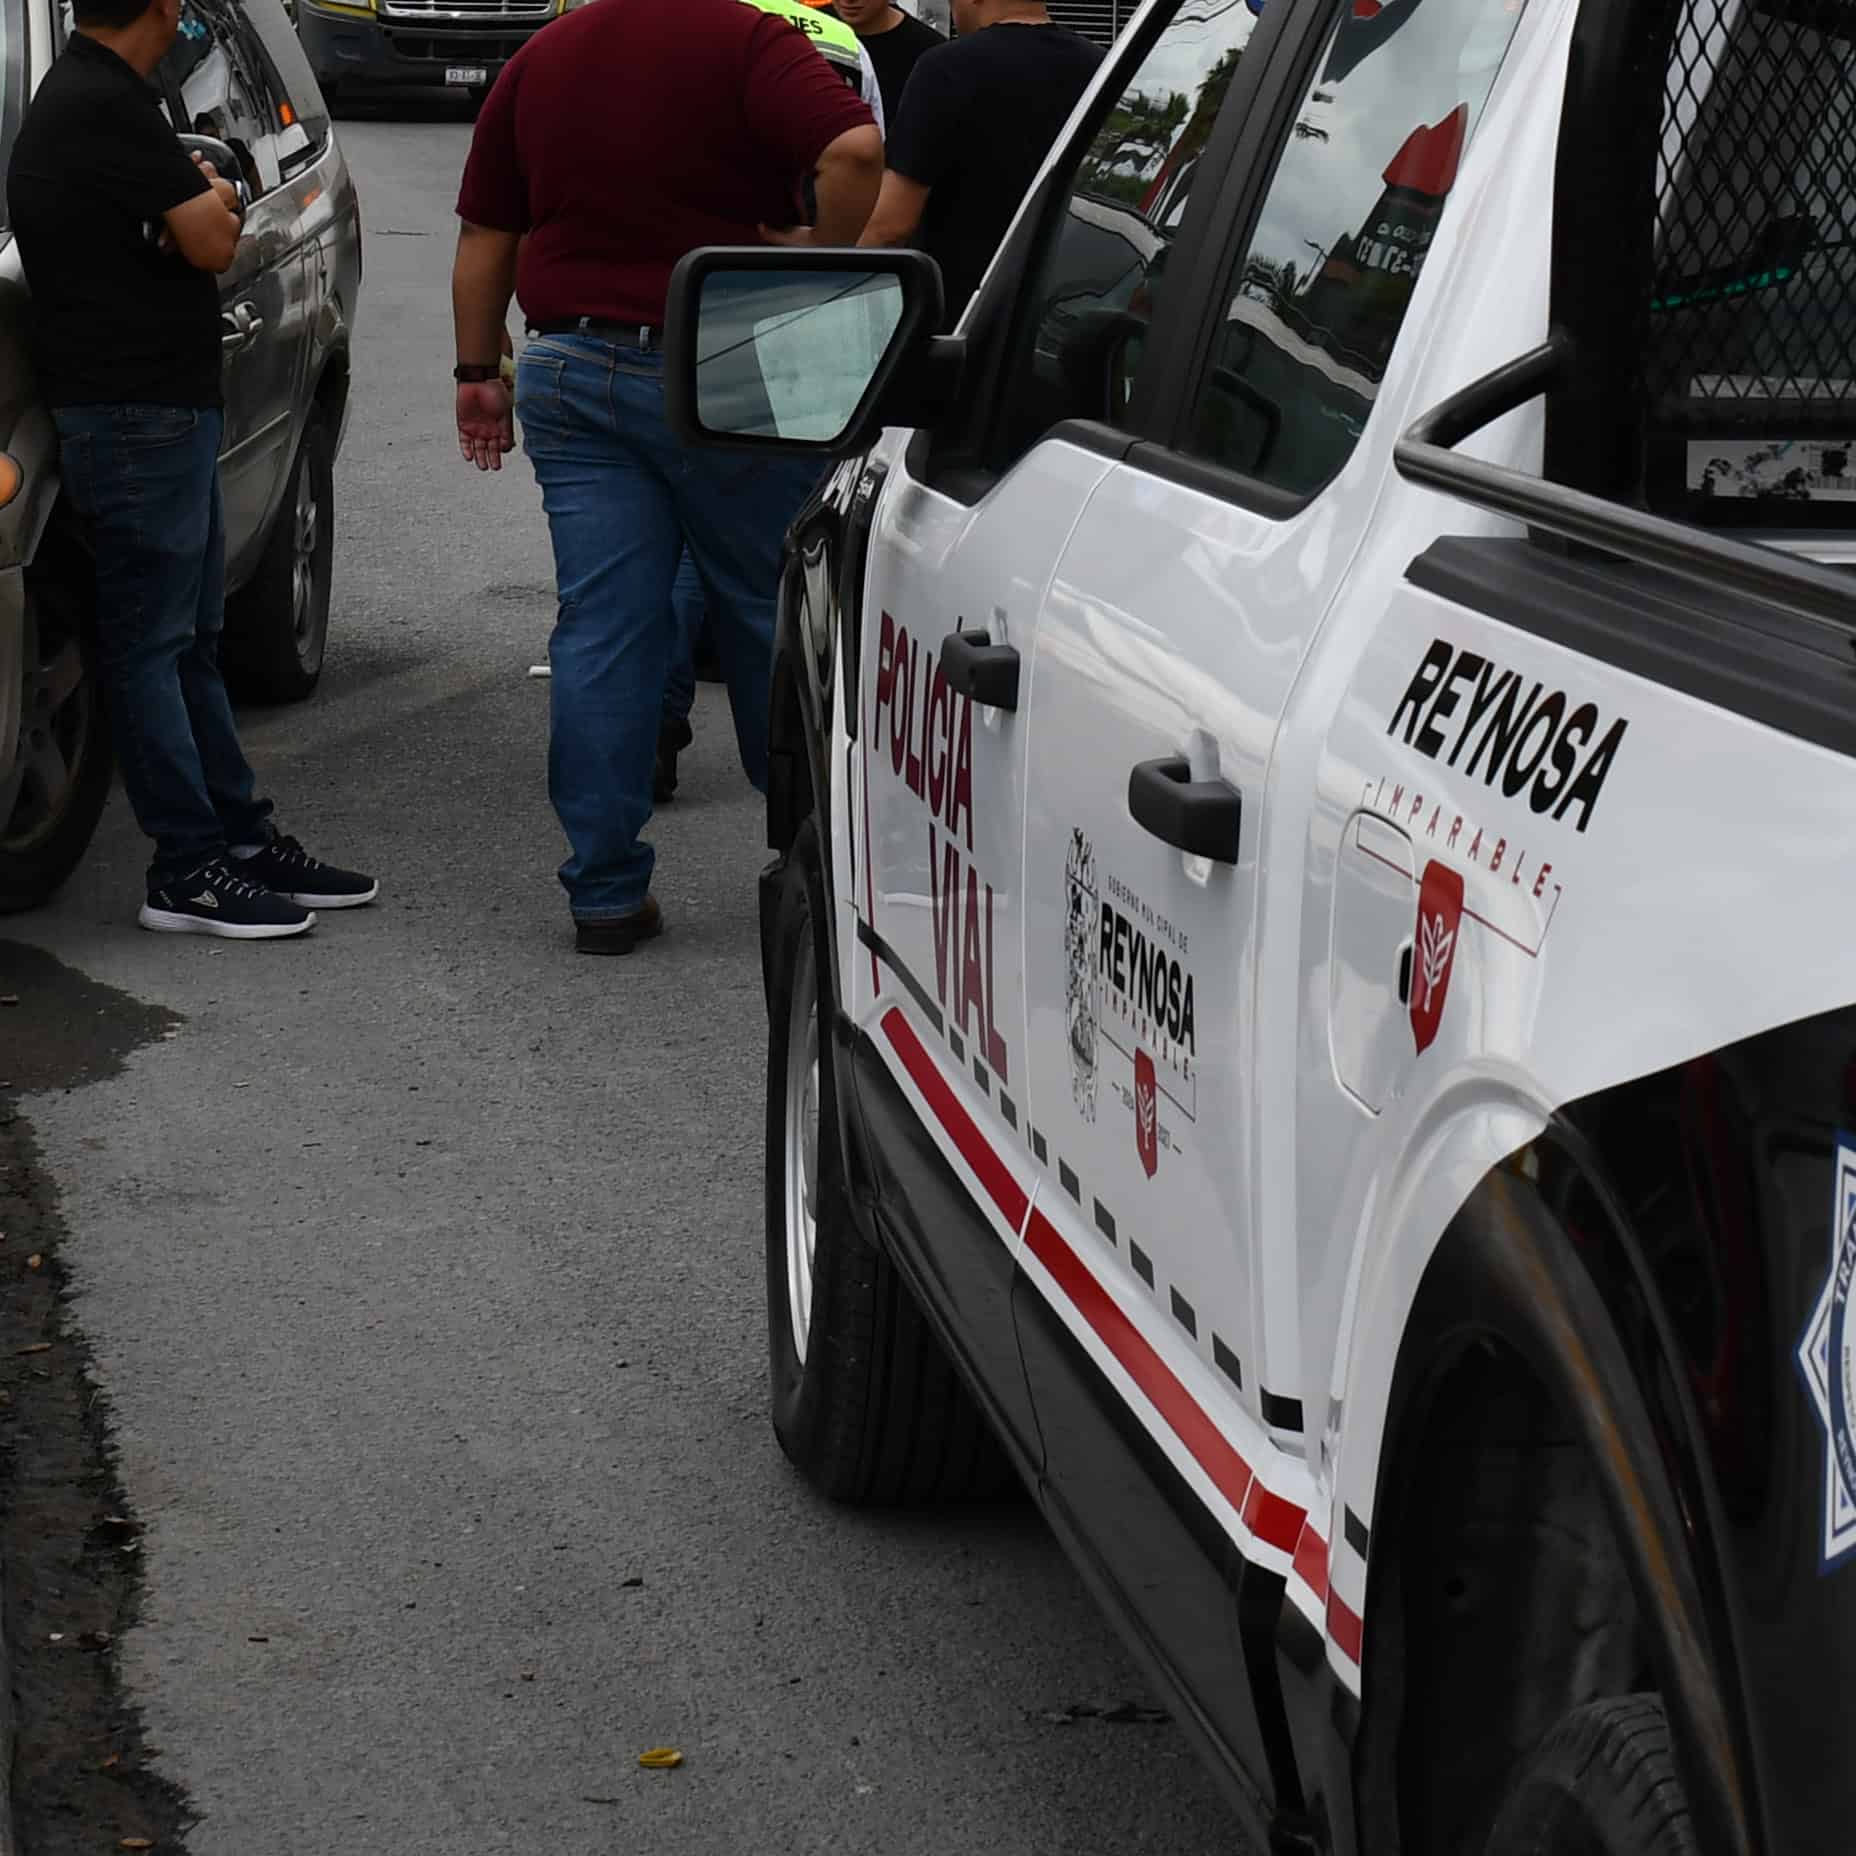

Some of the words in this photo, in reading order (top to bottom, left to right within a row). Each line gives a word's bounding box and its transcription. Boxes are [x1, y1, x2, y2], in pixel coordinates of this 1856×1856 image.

[1386, 638, 1629, 833] REYNOSA
[1374, 776, 1552, 898] IMPARABLE
[929, 821, 1008, 1086] VIAL
[1100, 901, 1195, 1058] REYNOSA
[1104, 983, 1189, 1082] IMPARABLE
